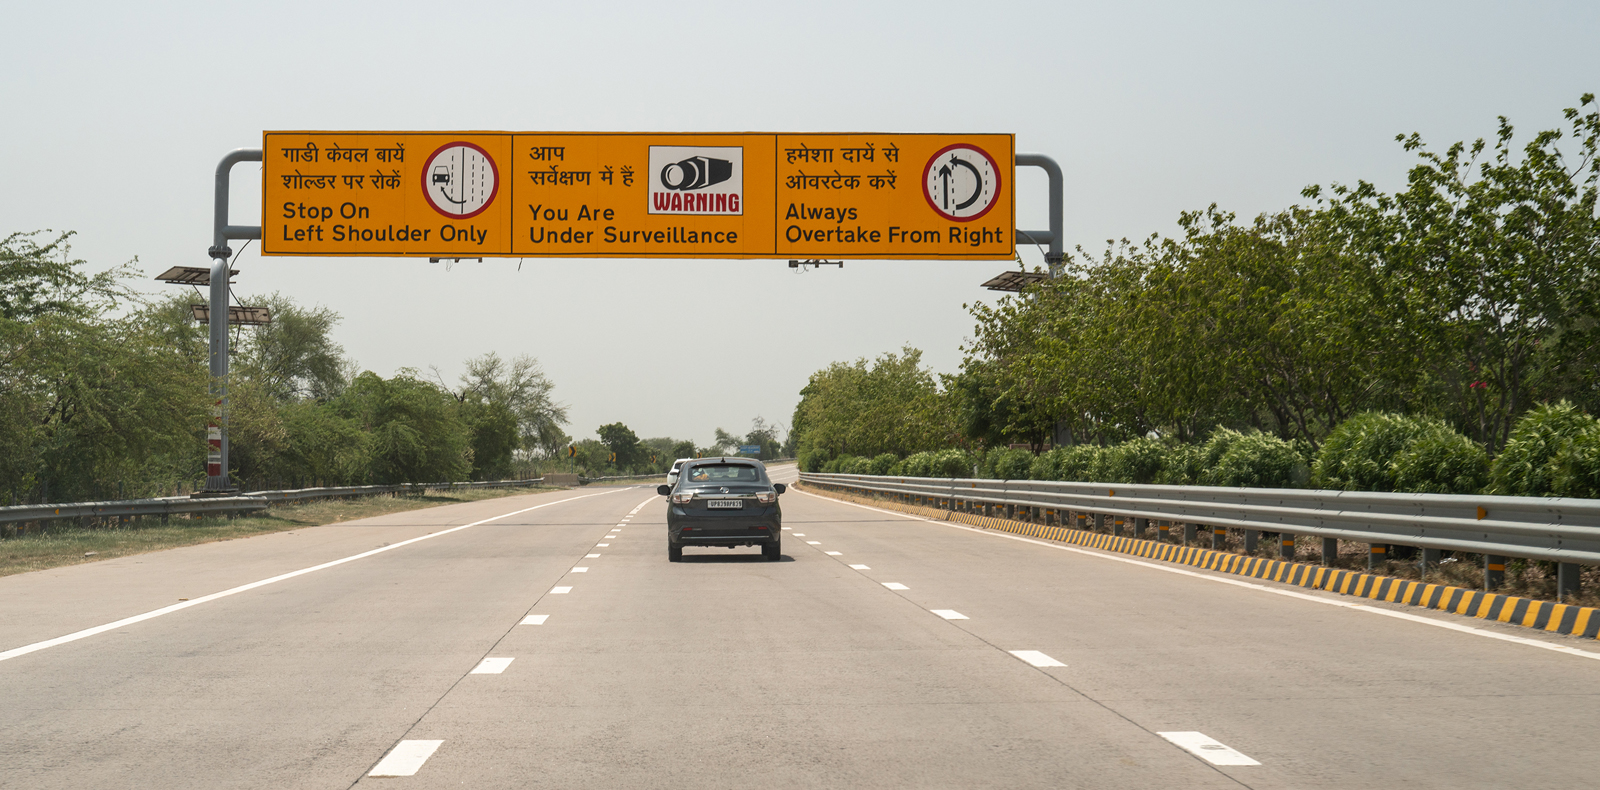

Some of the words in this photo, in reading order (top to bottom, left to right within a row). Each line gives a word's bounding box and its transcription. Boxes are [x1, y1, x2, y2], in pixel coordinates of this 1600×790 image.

[324, 142, 370, 163] केवल
[374, 142, 406, 163] बायें
[529, 146, 566, 162] आप
[784, 142, 835, 165] हमेशा
[839, 141, 876, 163] दायें
[881, 142, 900, 163] से
[280, 168, 337, 190] शोल्डर
[341, 174, 365, 190] पर
[369, 169, 402, 190] रोकें
[527, 164, 592, 186] सर्वेक्षण
[598, 164, 614, 186] में
[620, 164, 635, 188] हैं
[785, 169, 862, 190] ओवरटेक
[866, 169, 898, 190] करें
[282, 201, 334, 223] Stop
[339, 201, 370, 220] On
[528, 204, 568, 222] You
[577, 204, 615, 221] Are
[653, 191, 740, 213] WARNING
[785, 202, 858, 224] Always
[283, 224, 324, 242] Left
[332, 224, 432, 242] Shoulder
[439, 224, 488, 246] Only
[529, 226, 594, 244] Under
[603, 225, 738, 244] Surveillance
[785, 224, 882, 244] Overtake
[888, 226, 941, 244] From
[948, 226, 1003, 247] Right
